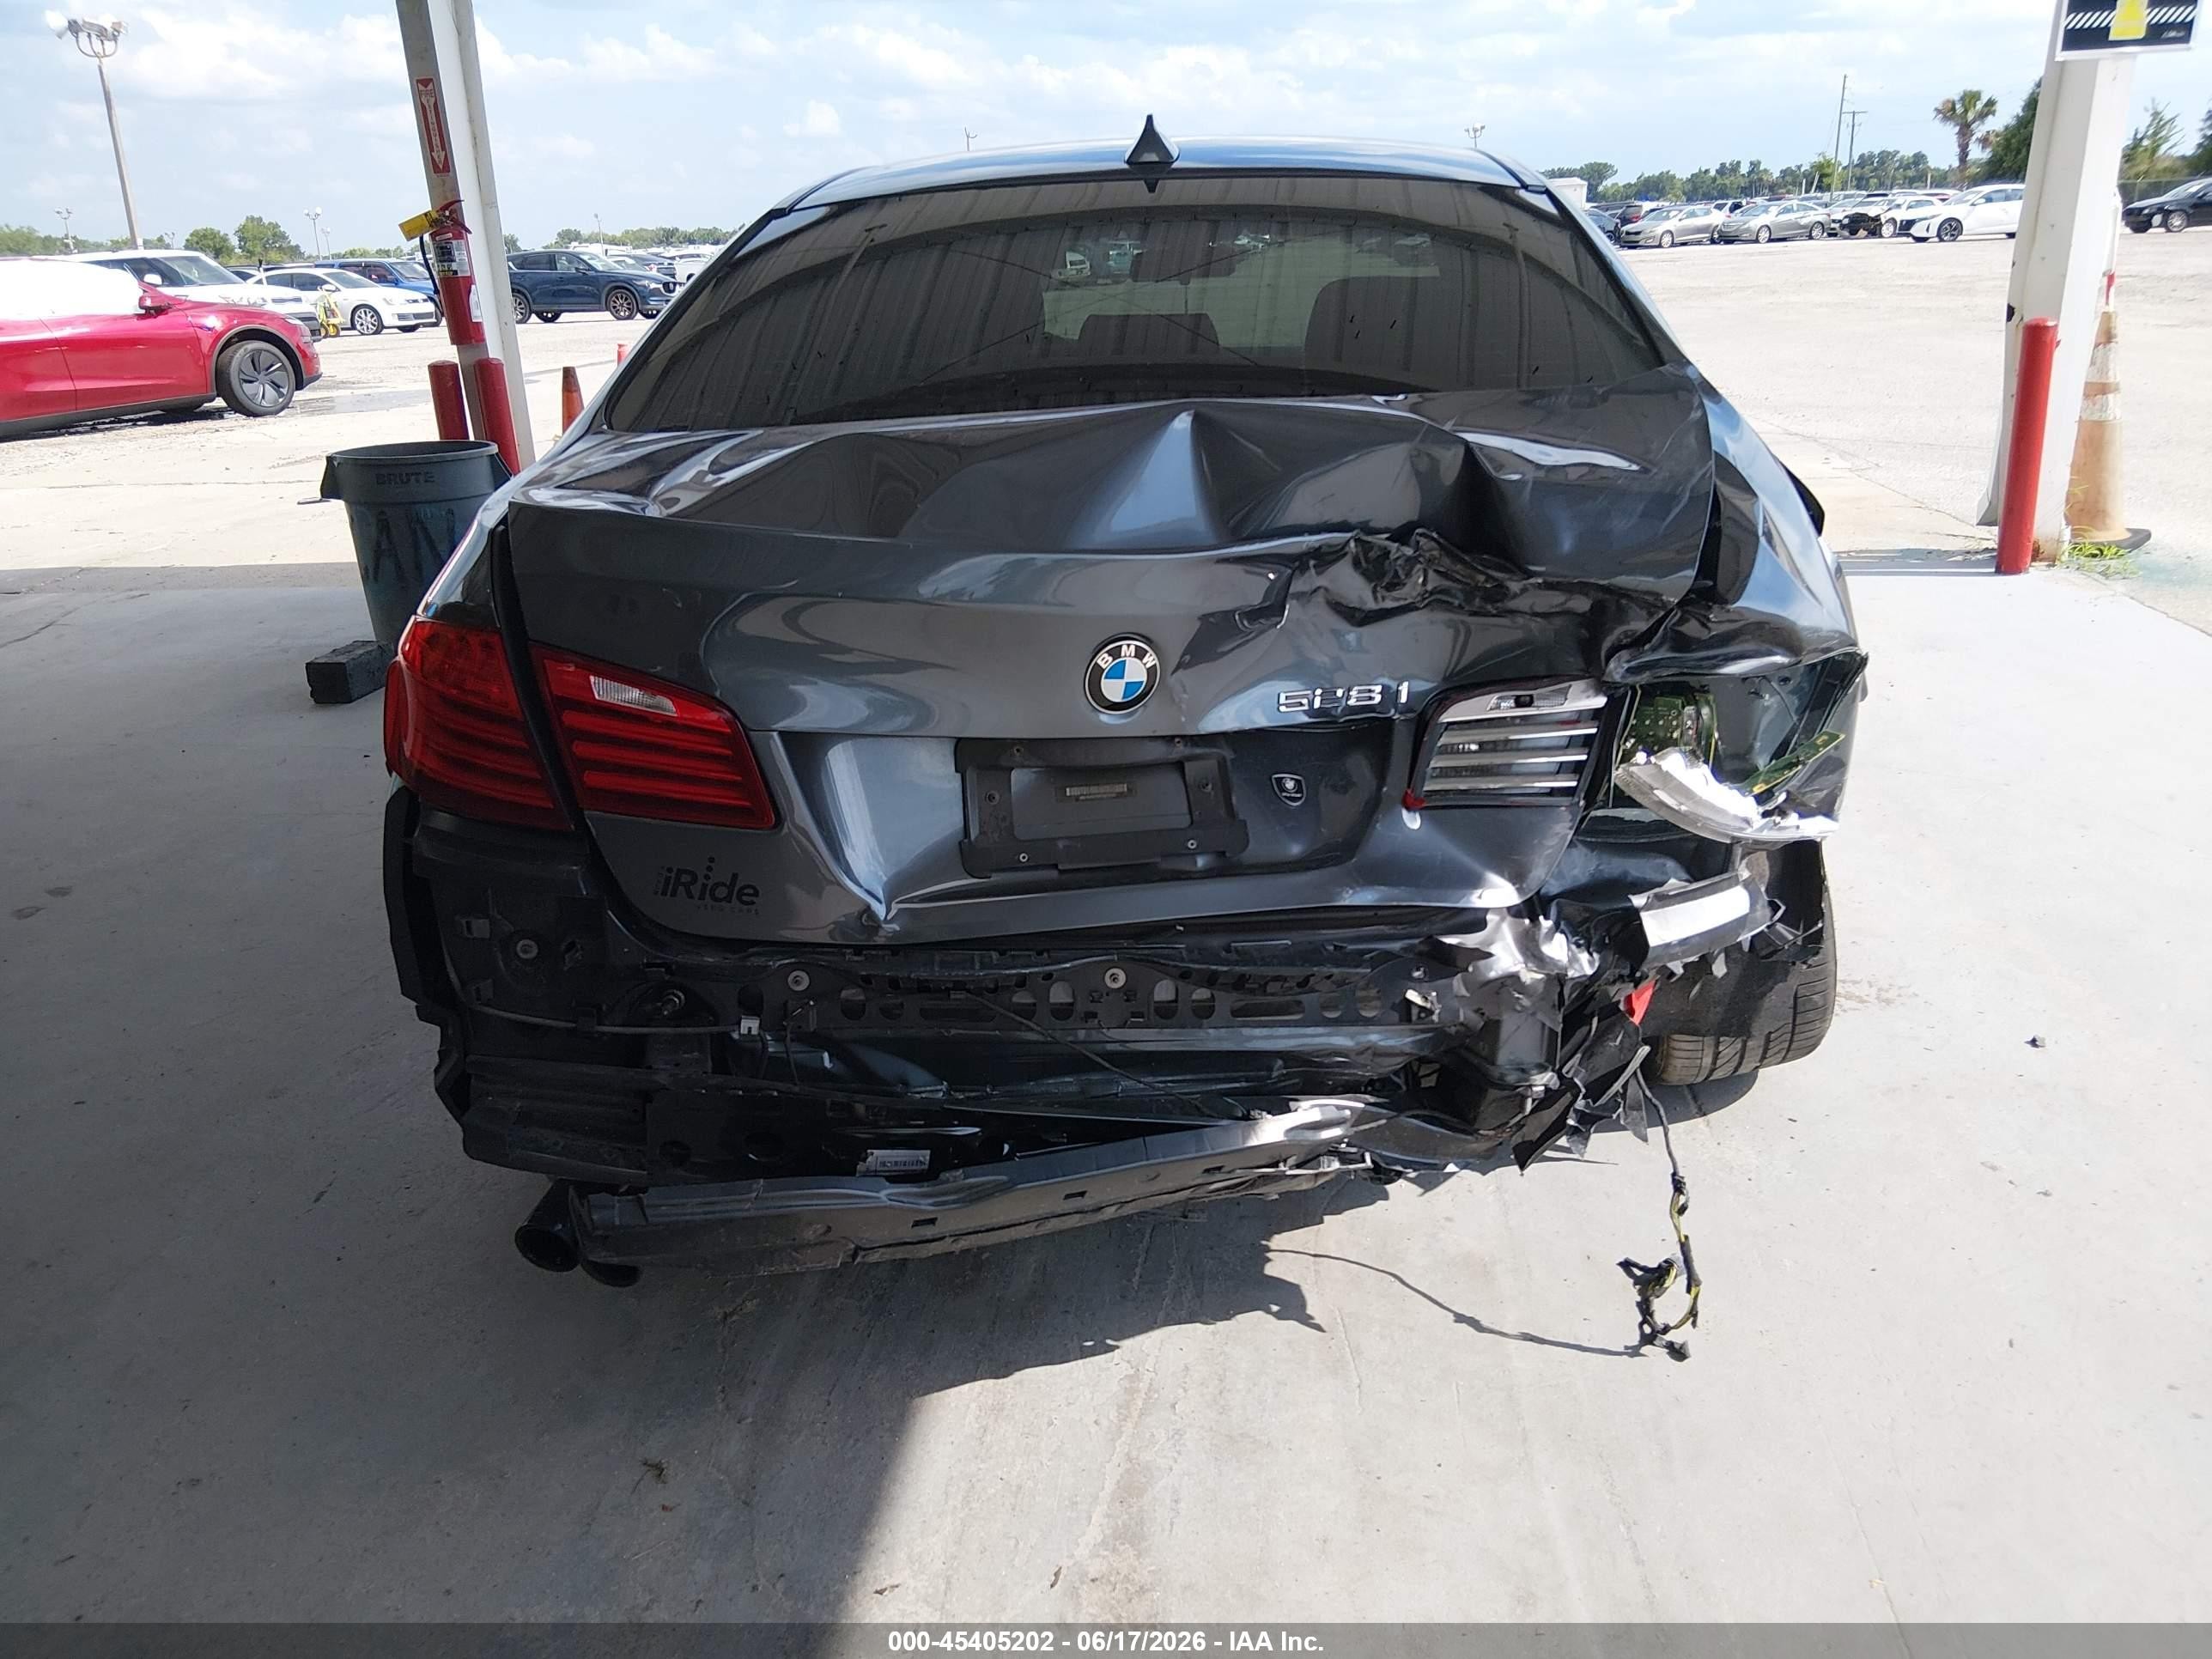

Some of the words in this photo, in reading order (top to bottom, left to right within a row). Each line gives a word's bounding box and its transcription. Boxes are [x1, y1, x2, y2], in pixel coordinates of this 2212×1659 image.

[419, 89, 434, 98] FIRE
[375, 472, 435, 485] BRUTE
[1097, 645, 1156, 670] BMW
[659, 856, 760, 906] iRide
